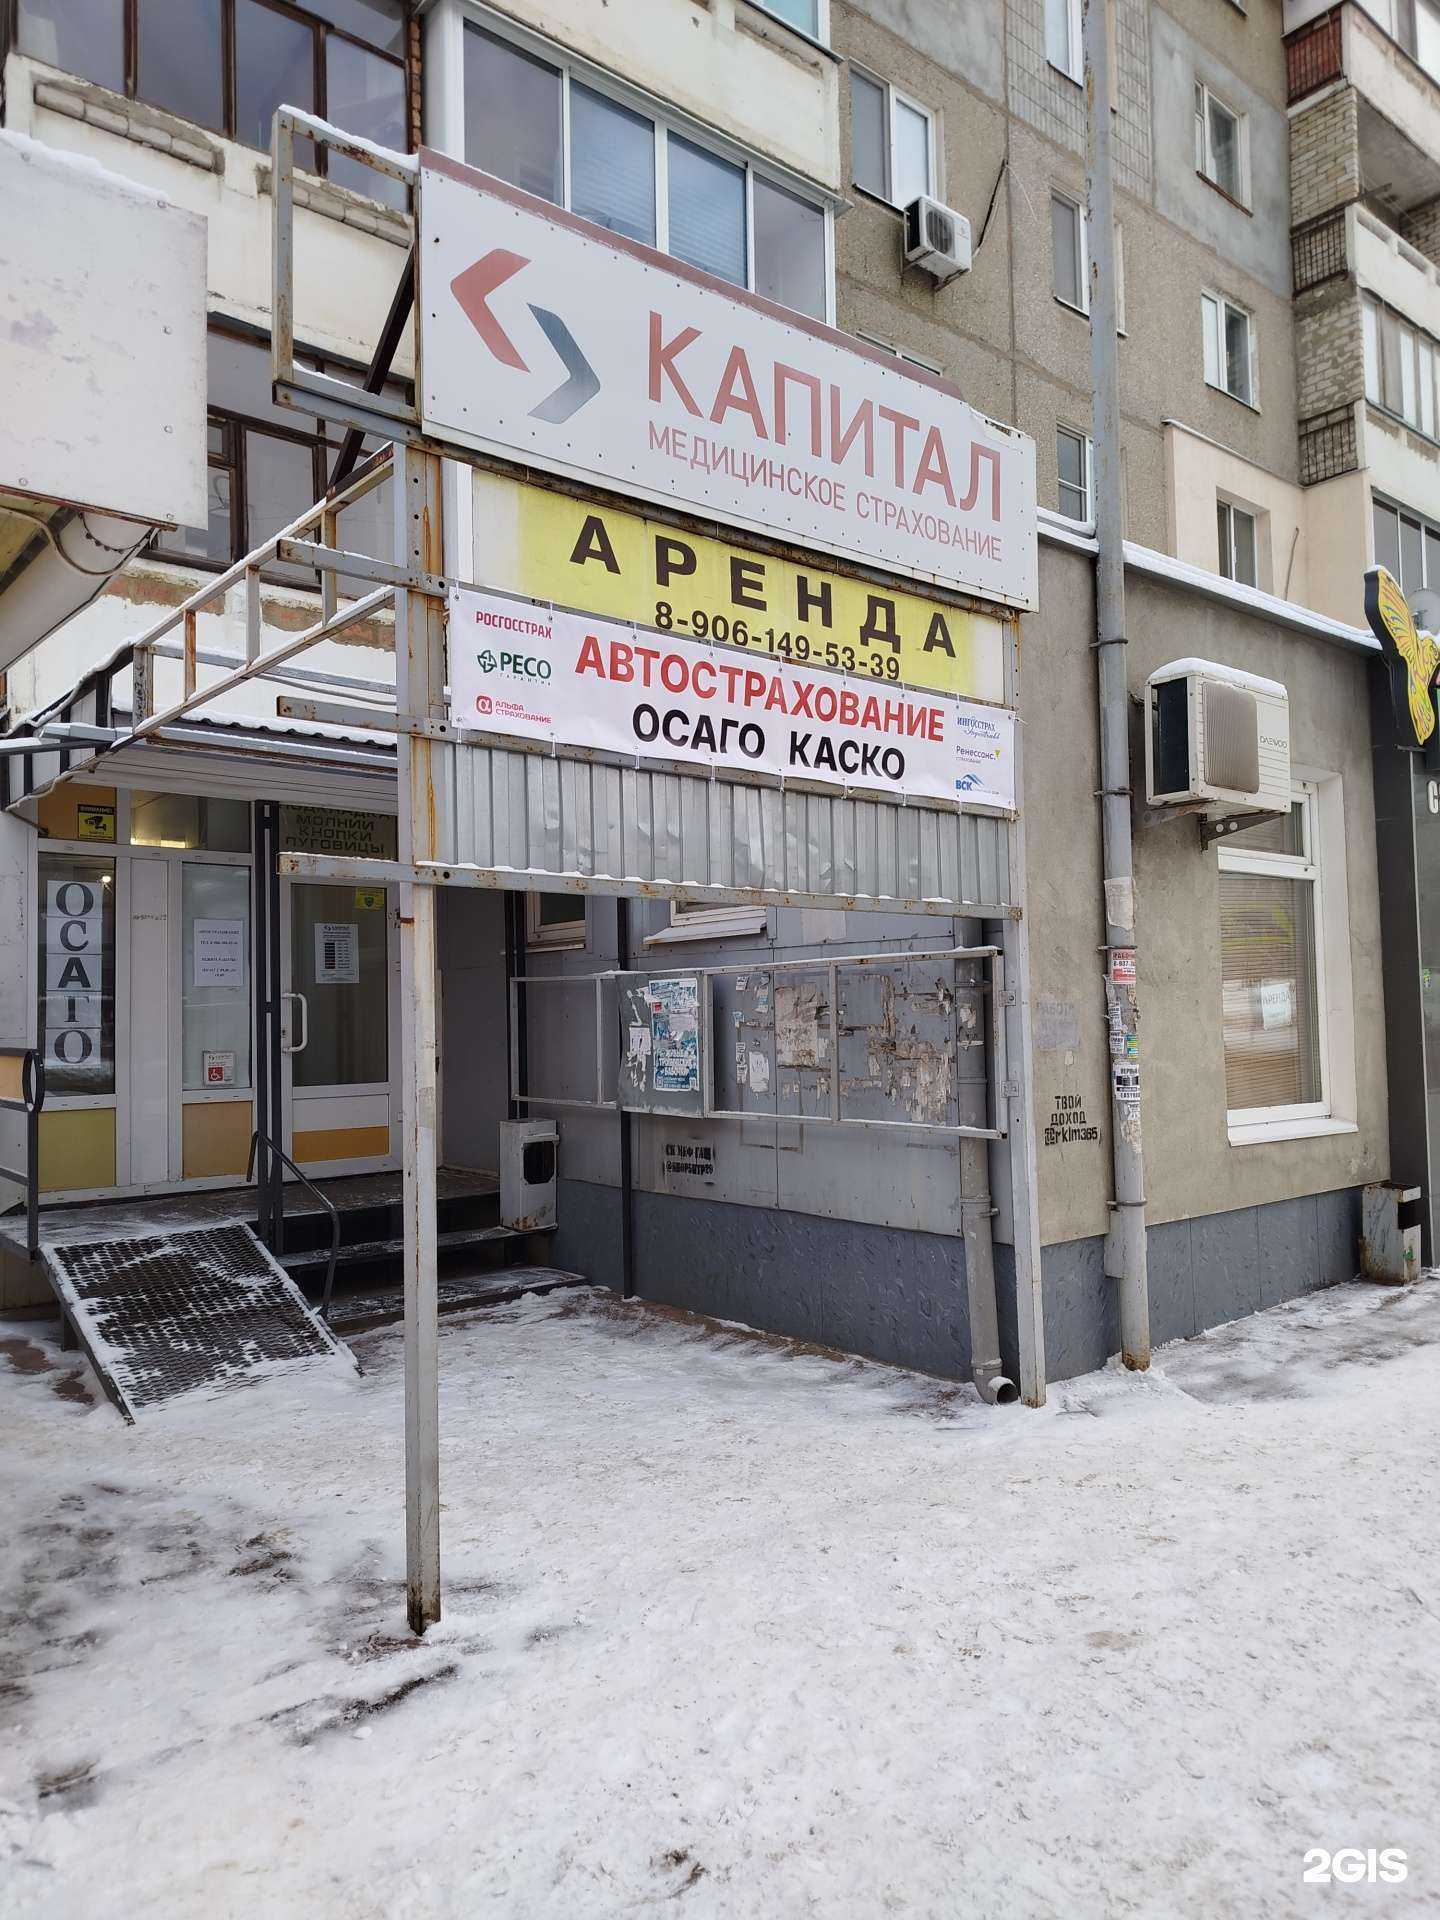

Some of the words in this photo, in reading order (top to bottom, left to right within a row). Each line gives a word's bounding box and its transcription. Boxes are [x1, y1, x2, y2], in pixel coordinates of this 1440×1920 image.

[648, 311, 1002, 521] КАПИТАЛ
[649, 421, 846, 512] МЕДИЦИНСКОЕ
[856, 492, 1003, 562] СТРАХОВАНИЕ
[569, 515, 958, 662] АРЕНДА
[476, 611, 552, 639] РОСГОССТРАХ
[654, 601, 901, 680] 8-906-149-53-39
[500, 652, 552, 679] РЕСО
[574, 635, 945, 742] АВТОСТРАХОВАНИЕ
[495, 701, 524, 711] АЛЬФА
[496, 708, 552, 723] СТРАХОВАНИЕ
[633, 703, 765, 759] ОСАГО
[790, 730, 905, 780] КАСКО
[1260, 735, 1288, 749] DAEWOO
[956, 780, 972, 791] ВСК
[286, 837, 384, 855] ПУГОВИЦЫ
[299, 826, 372, 842] КНОПКИ
[54, 882, 95, 1065] ОСАГО
[1054, 1094, 1082, 1110] ТВОЙ
[1050, 1111, 1087, 1126] ДОХОД
